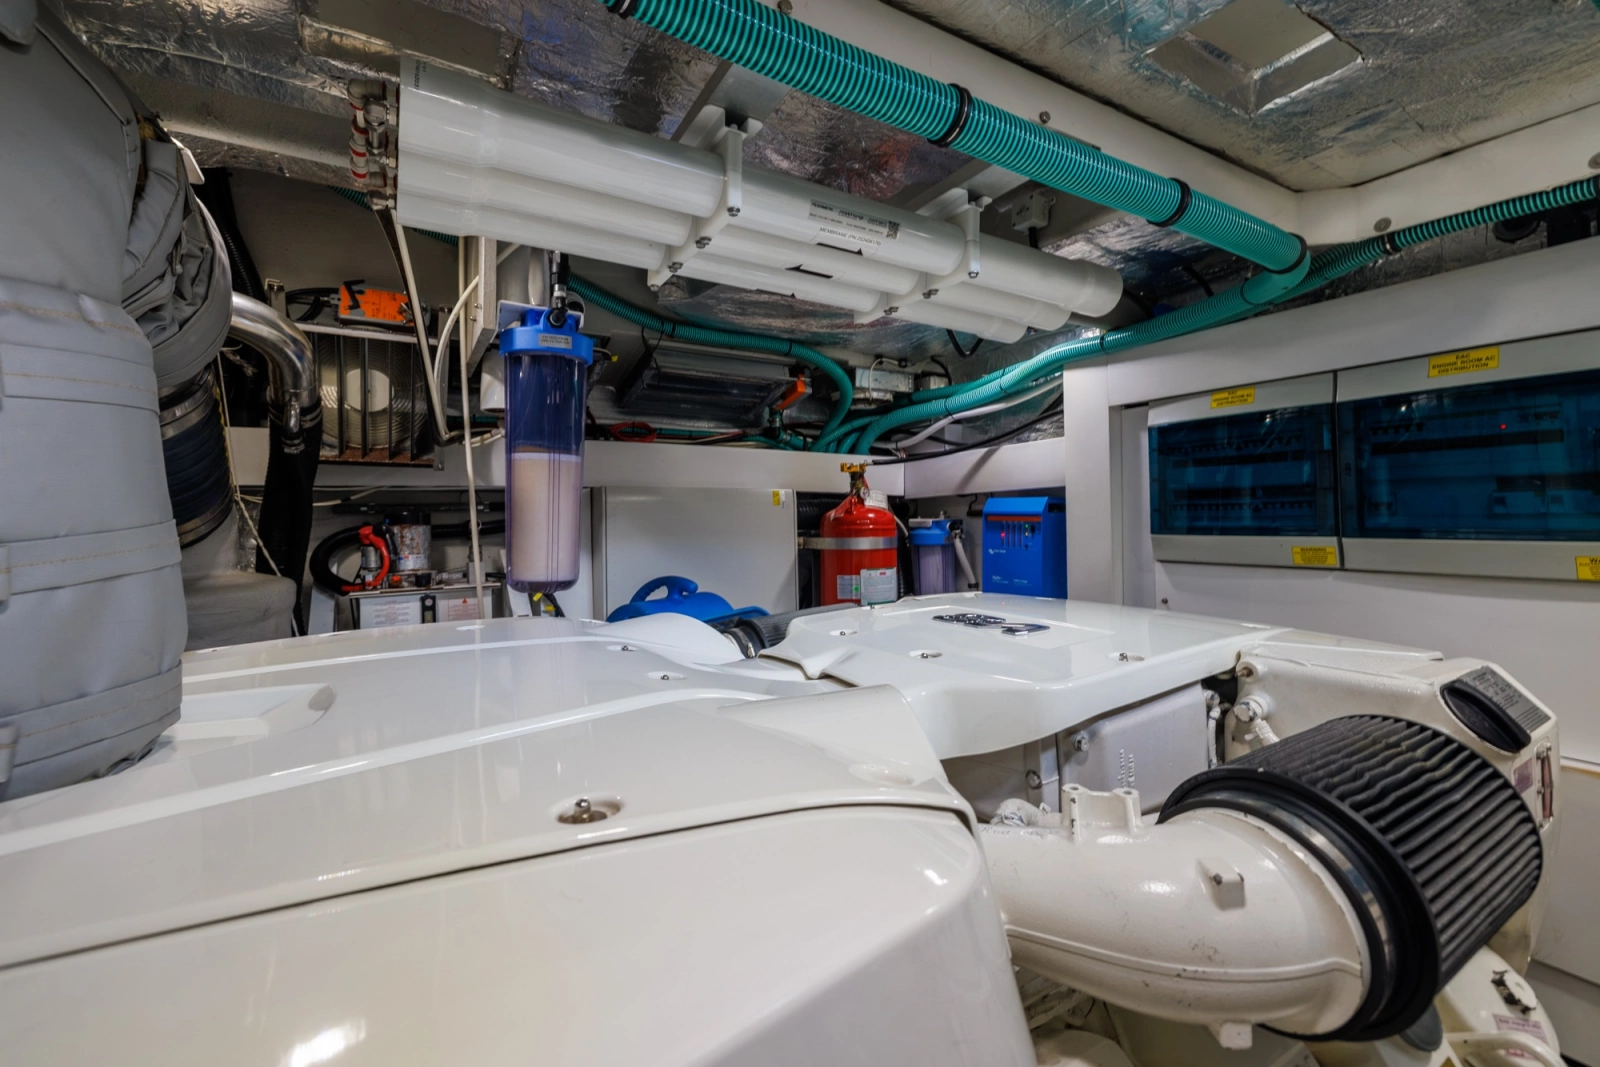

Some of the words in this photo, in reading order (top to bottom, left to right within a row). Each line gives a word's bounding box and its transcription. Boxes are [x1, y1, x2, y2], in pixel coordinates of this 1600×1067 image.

[819, 226, 848, 239] MEMBRANE
[1432, 360, 1458, 369] ENGINE
[1460, 356, 1483, 365] ROOM
[1437, 362, 1489, 374] DISTRIBUTION
